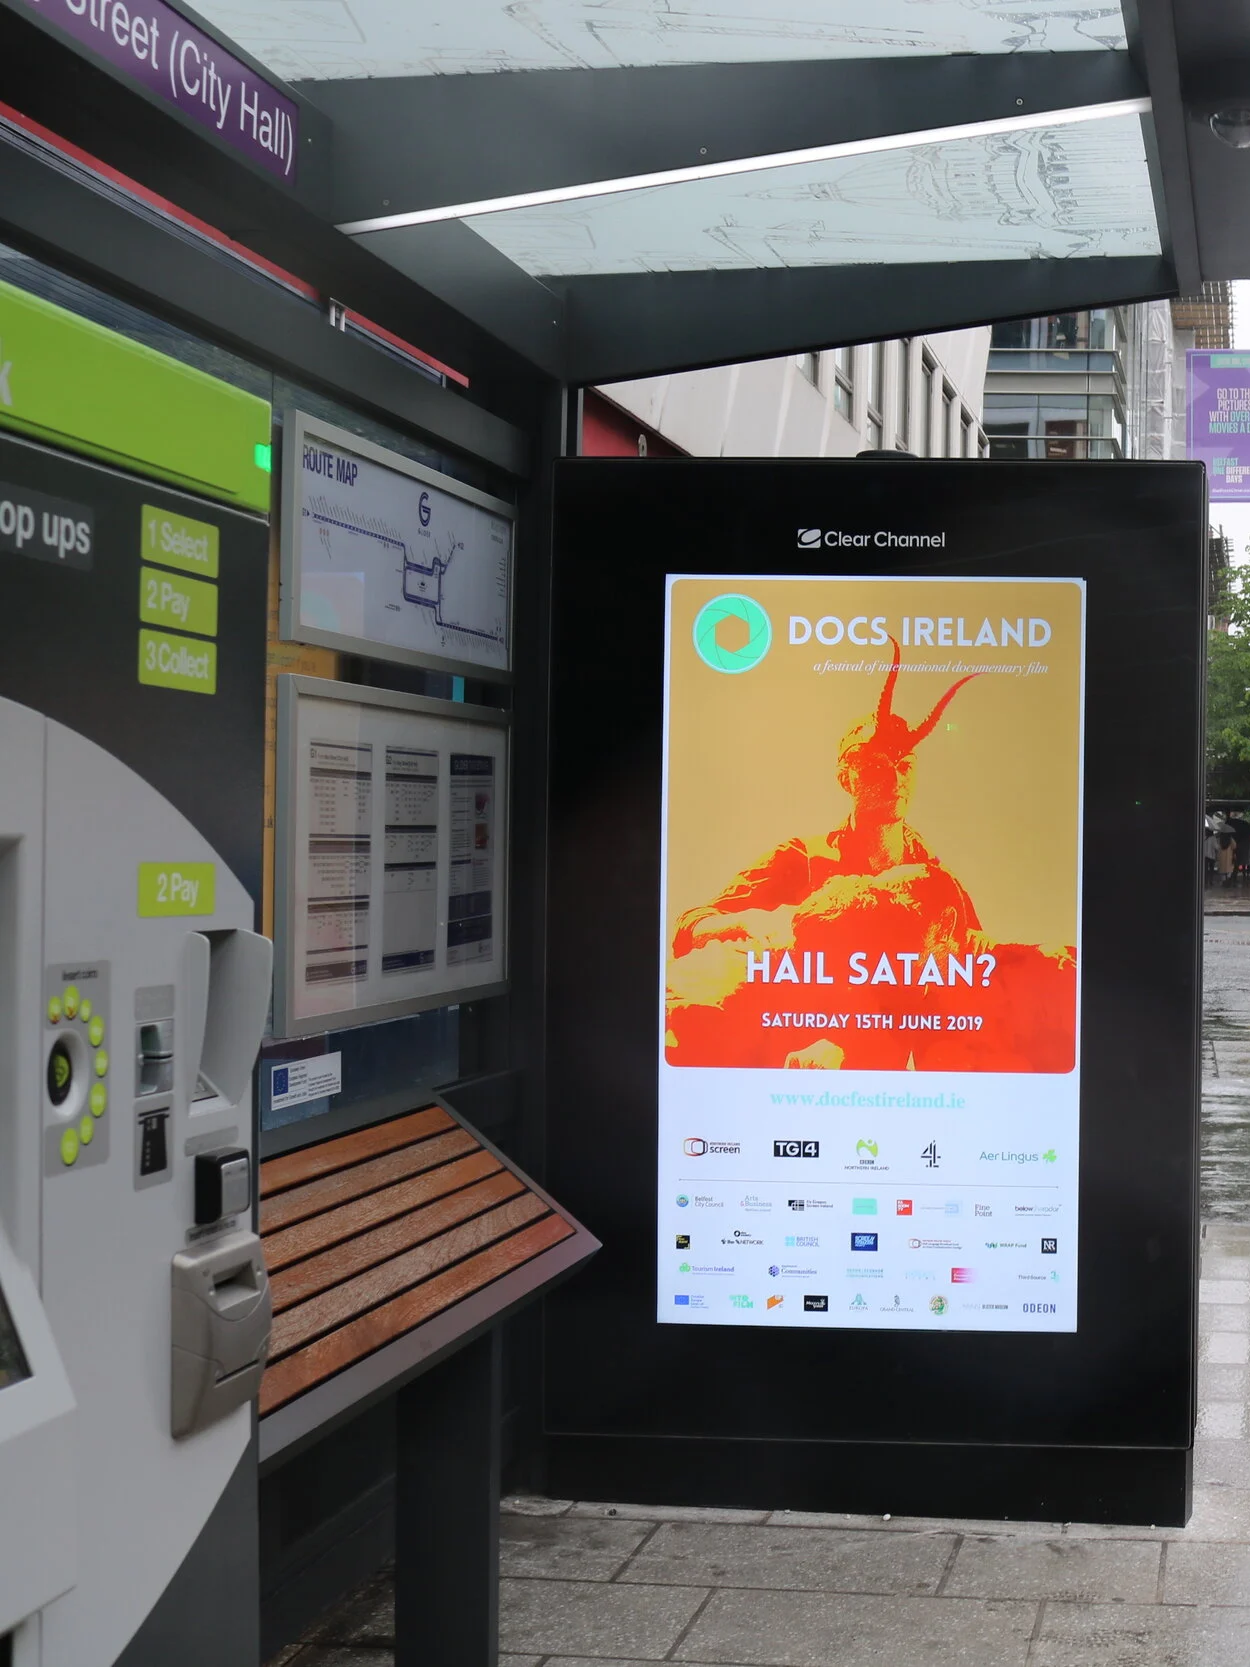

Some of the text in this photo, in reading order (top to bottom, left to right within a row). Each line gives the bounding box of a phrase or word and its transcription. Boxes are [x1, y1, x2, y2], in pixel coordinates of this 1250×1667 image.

[170, 30, 232, 130] (City
[240, 81, 293, 176] Hall)
[1216, 387, 1227, 400] GO
[1229, 387, 1238, 400] TO
[1209, 411, 1229, 422] WITH
[1231, 411, 1250, 422] OVER
[1209, 422, 1238, 434] MOVIES
[1240, 423, 1246, 434] A
[303, 444, 358, 487] ROUTE MAP
[1226, 475, 1243, 484] DAYS
[43, 512, 91, 559] ups
[148, 519, 209, 562] 1 Select
[824, 530, 946, 548] Clear Channel
[147, 579, 191, 622] 2 Pay
[788, 615, 1052, 648] DOCS IRELAND
[146, 640, 209, 680] 3 Collect
[813, 658, 1049, 677] a festival of international documentary film
[156, 872, 200, 907] 2 Pay
[746, 949, 997, 988] HAIL SATAN?
[761, 1012, 983, 1031] SATURDAY 15TH JUNE 2019
[769, 1090, 966, 1109] www.docfestireland.ie
[709, 1146, 741, 1154] screen
[979, 1151, 1039, 1164] Aer Lingus
[714, 1265, 735, 1273] Ireland
[1022, 1302, 1057, 1314] ODEON
